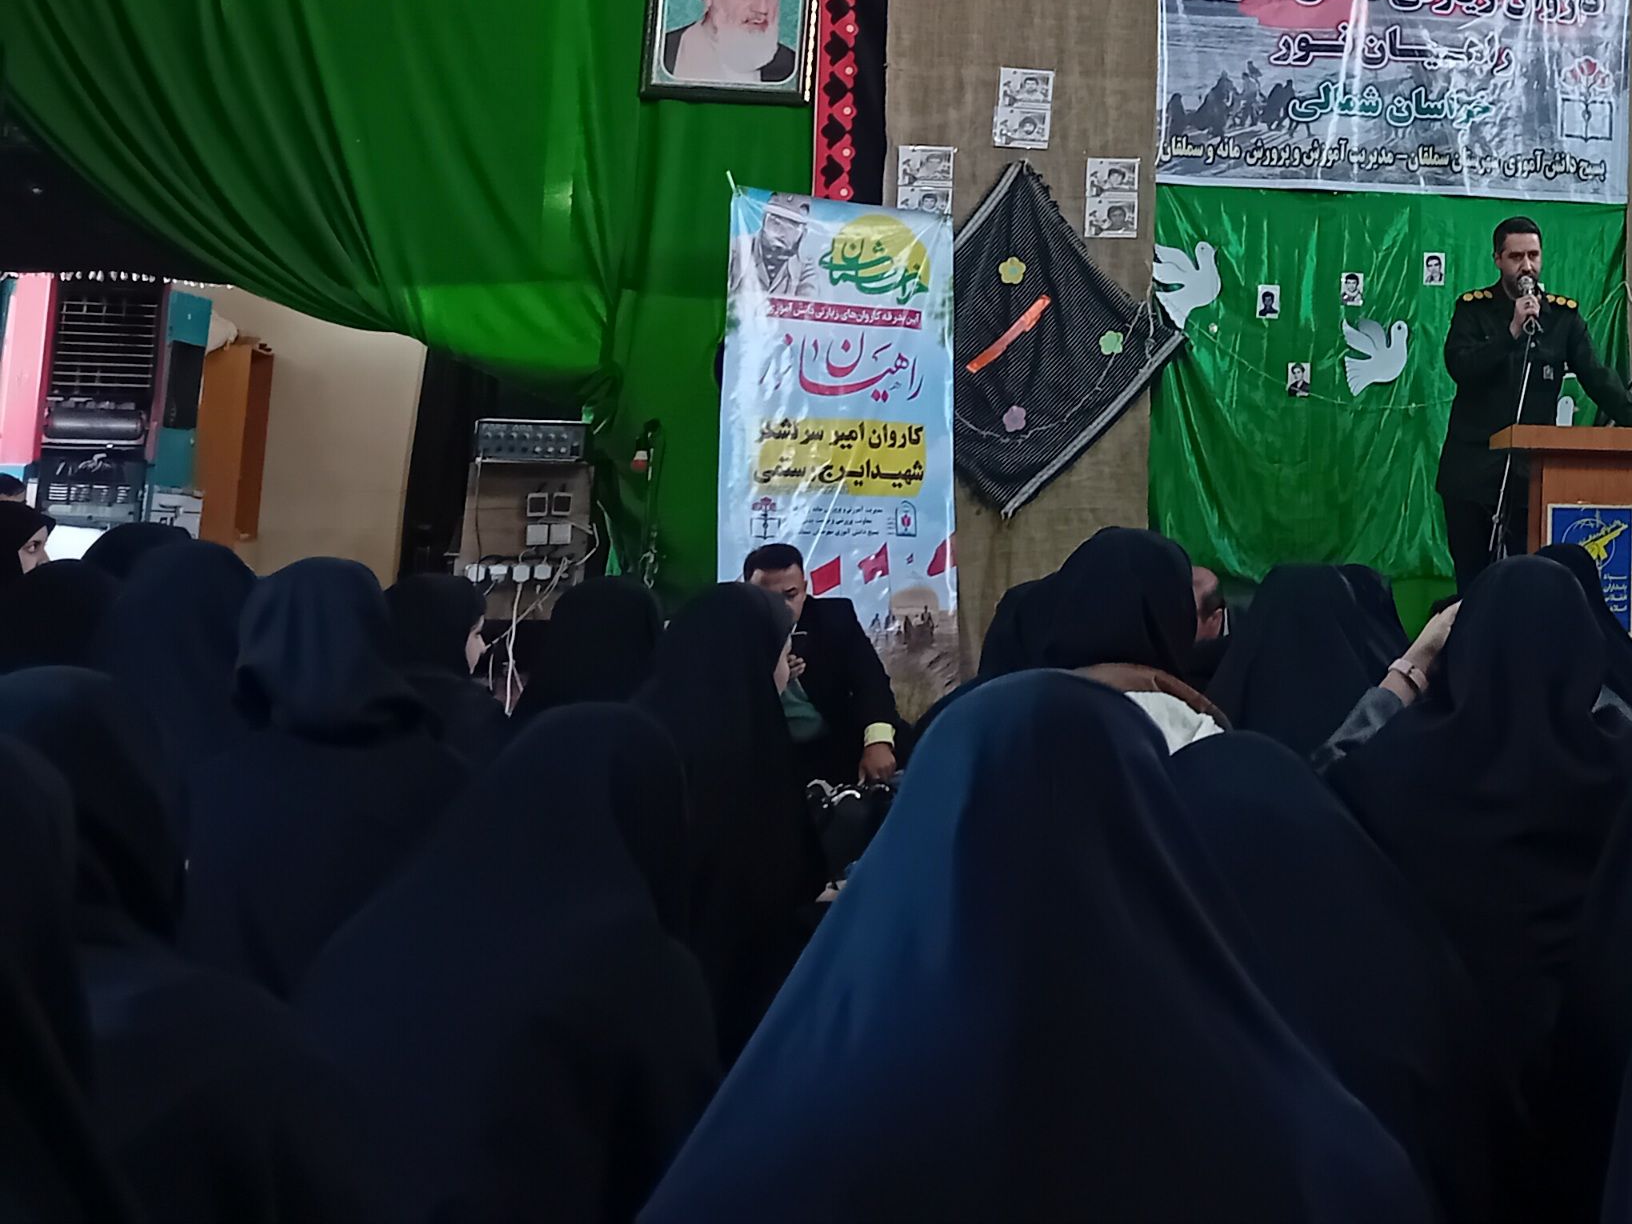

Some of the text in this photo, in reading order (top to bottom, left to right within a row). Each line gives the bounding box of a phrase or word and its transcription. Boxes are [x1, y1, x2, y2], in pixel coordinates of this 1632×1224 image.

[1270, 22, 1353, 66] نور
[1288, 80, 1495, 130] خراسان شمالی
[1205, 144, 1215, 164] و
[1216, 136, 1242, 159] مانه
[1245, 138, 1292, 168] پرورش
[1292, 150, 1301, 167] و
[1302, 138, 1348, 169] آموزش
[1349, 147, 1395, 171] مدیریت
[829, 420, 865, 450] امیر
[868, 423, 924, 450] کاروان
[871, 459, 925, 489] شهید
